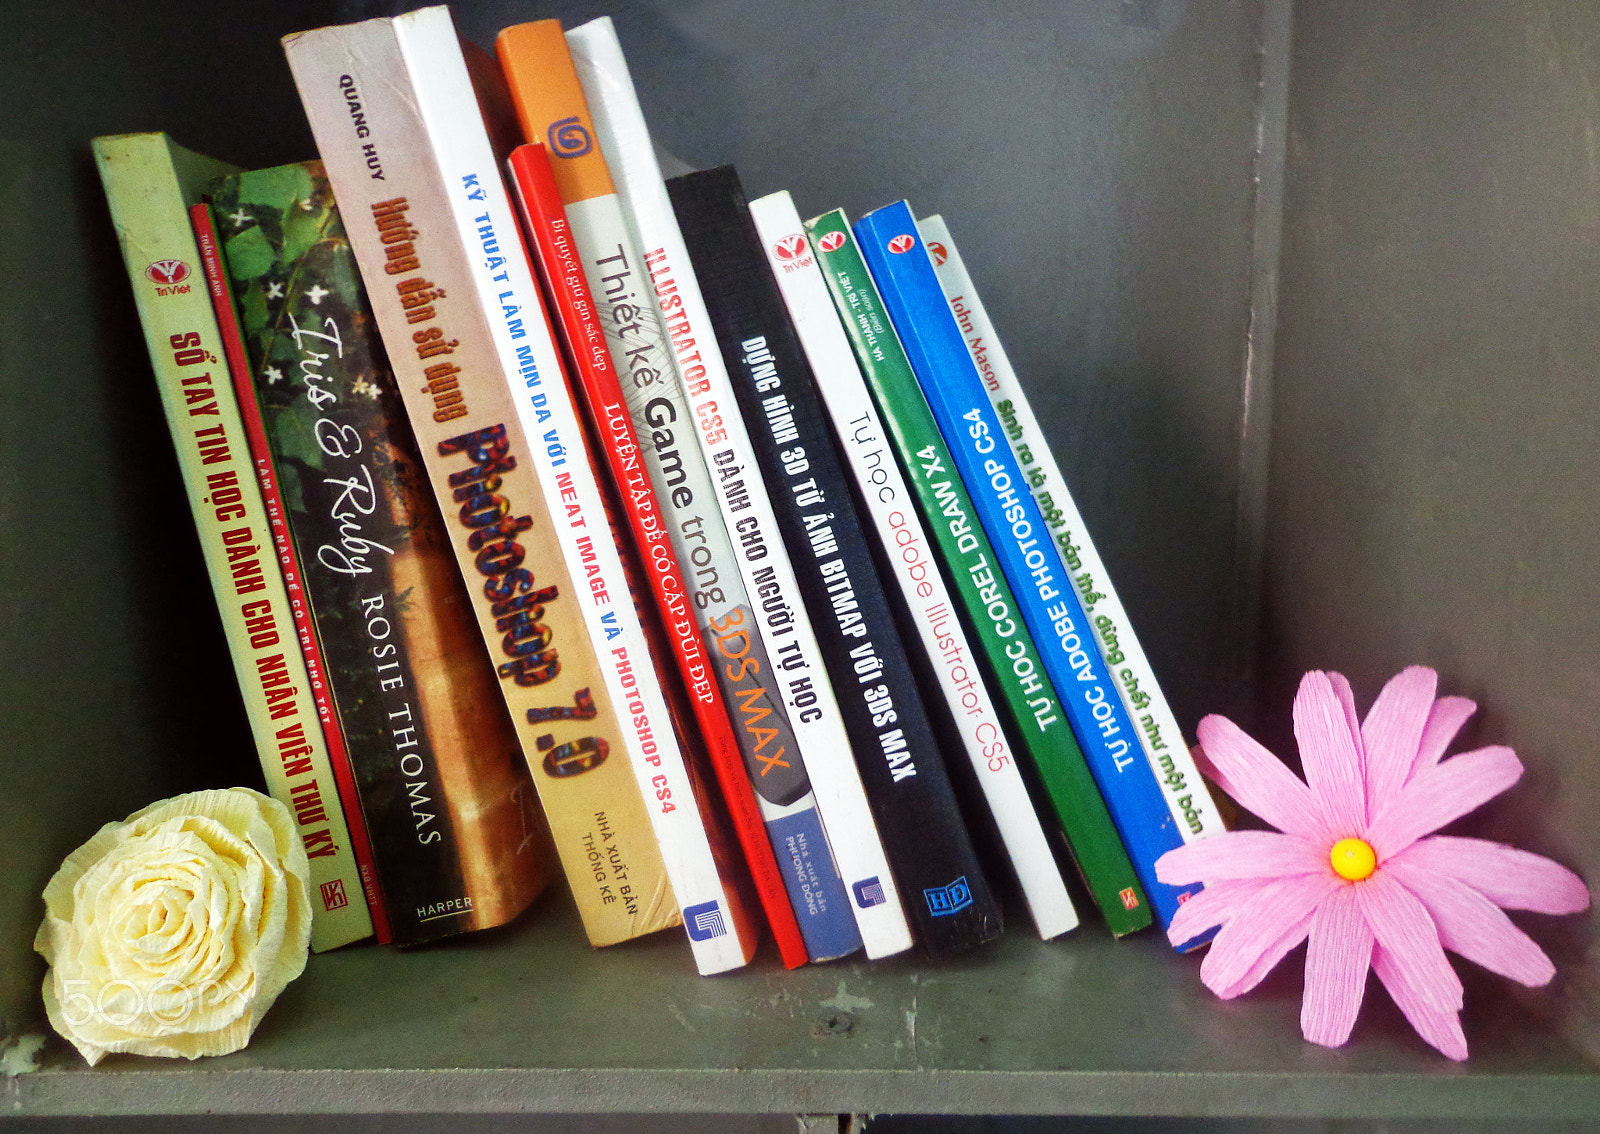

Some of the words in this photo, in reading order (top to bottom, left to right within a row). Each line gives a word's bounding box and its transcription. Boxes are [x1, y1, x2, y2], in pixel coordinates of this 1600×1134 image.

[339, 74, 369, 138] QUANG
[362, 143, 384, 180] HUY
[462, 173, 486, 200] KỸ
[371, 197, 420, 275] Hướng
[474, 211, 509, 281] THUẬT
[396, 277, 446, 324] dẫn
[498, 290, 526, 339] LÀM
[644, 248, 710, 396] ILLUSTRATOR
[169, 332, 216, 366] SỔ
[288, 312, 355, 410] Iris
[412, 327, 459, 359] sử
[741, 336, 780, 392] DỰNG
[515, 345, 540, 387] MỊN
[181, 372, 219, 416] TAY
[420, 362, 468, 423] dụng
[530, 393, 551, 423] DA
[314, 418, 361, 458] &
[604, 402, 638, 470] LUYỆN
[696, 400, 727, 445] CS5
[762, 394, 798, 444] HÌNH
[962, 408, 994, 453] CS4
[194, 423, 231, 464] TIN
[543, 428, 566, 466] VỚI
[780, 446, 808, 474] 3D
[916, 444, 945, 478] X4
[204, 470, 245, 521] HỌC
[258, 459, 271, 488] LÀM
[627, 472, 651, 510] TẬP
[712, 448, 751, 512] DÀNH
[792, 477, 824, 506] TỪ
[268, 498, 283, 525] THẾ
[317, 464, 398, 577] Ruby
[555, 472, 586, 527] NEAT
[596, 244, 641, 338] Thiết
[625, 345, 663, 388] kế
[644, 397, 692, 508] Game
[680, 516, 725, 604] trong
[708, 607, 758, 682] 3DS
[735, 688, 789, 776] MAX
[930, 480, 978, 553] DRAW
[276, 534, 289, 563] NÀO
[640, 514, 667, 542] ĐỂ
[736, 516, 767, 561] CHO
[802, 512, 838, 556] ẢNH
[984, 459, 1059, 600] PHOTOSHOP
[221, 526, 265, 594] DÀNH
[286, 572, 299, 589] ĐỂ
[576, 536, 609, 605] IMAGE
[651, 544, 674, 572] CÓ
[292, 599, 303, 617] CÓ
[437, 423, 560, 687] Photoshop
[525, 687, 609, 778] 7.0
[661, 575, 684, 615] CẶP
[752, 566, 794, 636] NGƯỜI
[819, 558, 866, 637] BITMAP
[849, 411, 875, 444] Tự
[863, 449, 894, 503] học
[888, 511, 932, 597] adobe
[925, 602, 982, 716] Illustrator
[975, 722, 1009, 771] CS5
[968, 553, 1015, 637] COREL
[241, 599, 279, 648] CHO
[298, 626, 312, 650] TRÍ
[600, 611, 623, 640] VÀ
[996, 399, 1022, 440] Sinh
[1016, 443, 1033, 465] ra
[1027, 467, 1046, 488] là
[1037, 491, 1065, 528] một
[1055, 531, 1081, 571] bản
[1074, 572, 1106, 613] thể,
[1094, 615, 1124, 665] đừng
[1119, 668, 1150, 710] chết
[1140, 714, 1167, 750] như
[1158, 754, 1186, 791] một
[1177, 794, 1202, 834] bản
[674, 619, 699, 661] ĐÙI
[776, 640, 809, 670] TỰ
[849, 642, 882, 682] VỚI
[1047, 601, 1096, 680] ADOBE
[255, 653, 298, 720] NHÂN
[307, 659, 321, 688] NHỚ
[689, 663, 713, 702] ĐẸP
[314, 696, 329, 728] TỐT
[361, 594, 403, 691] ROSIE
[388, 702, 440, 843] THOMAS
[611, 647, 660, 766] PHOTOSHOP
[788, 676, 822, 722] HỌC
[864, 684, 896, 726] 3DS
[1026, 697, 1056, 731] TỰ
[1085, 686, 1119, 737] HỌC
[275, 722, 312, 777] VIÊN
[879, 728, 916, 782] MAX
[1104, 739, 1133, 772] TỰ
[290, 779, 329, 825] THƯ
[652, 774, 675, 813] CS4
[302, 828, 339, 859] KÝ
[594, 811, 614, 841] NHÀ
[606, 844, 628, 879] XUẤT
[620, 885, 637, 914] BẢN
[582, 832, 606, 882] THỐNG
[599, 885, 616, 904] KÊ
[417, 896, 473, 918] HARPER
